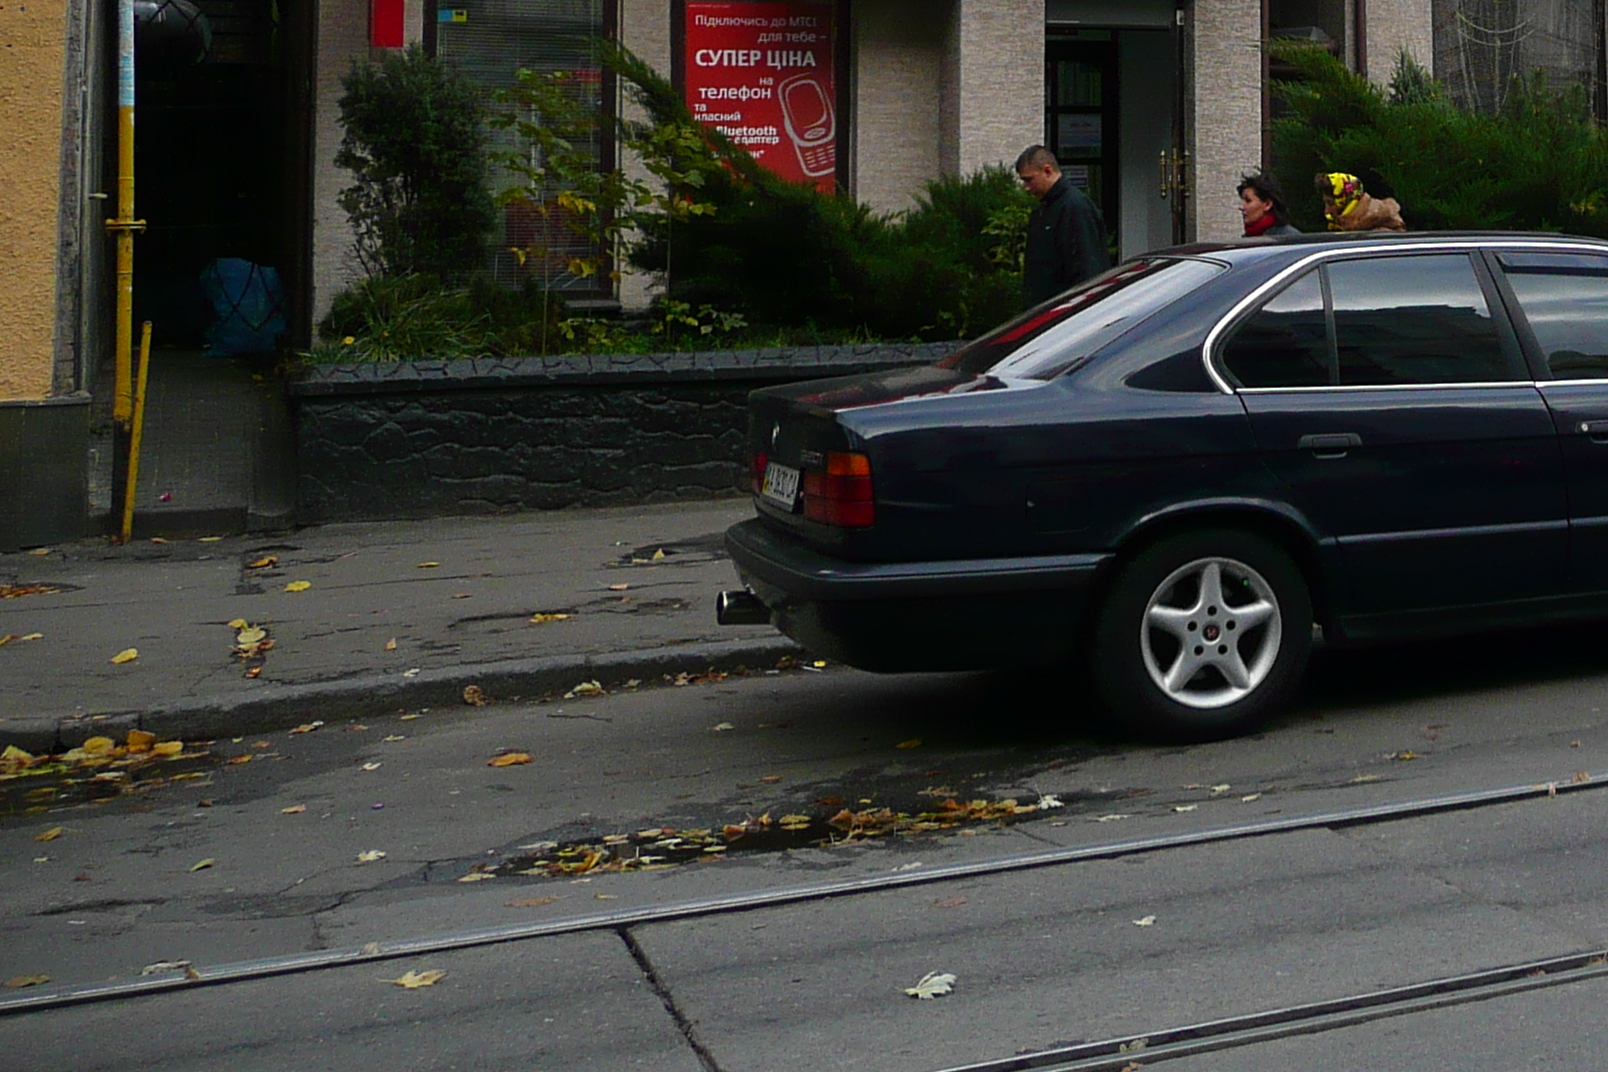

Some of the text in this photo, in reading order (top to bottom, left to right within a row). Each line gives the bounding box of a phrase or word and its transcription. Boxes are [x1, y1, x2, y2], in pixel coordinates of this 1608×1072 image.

[695, 14, 768, 28] Підключись
[770, 17, 786, 28] до
[757, 32, 782, 44] для
[785, 31, 816, 43] тебе
[695, 49, 816, 70] СУПЕР ЦІНА
[759, 77, 773, 85] на
[698, 85, 771, 101] телефон
[694, 103, 707, 112] та
[694, 112, 741, 121] класний
